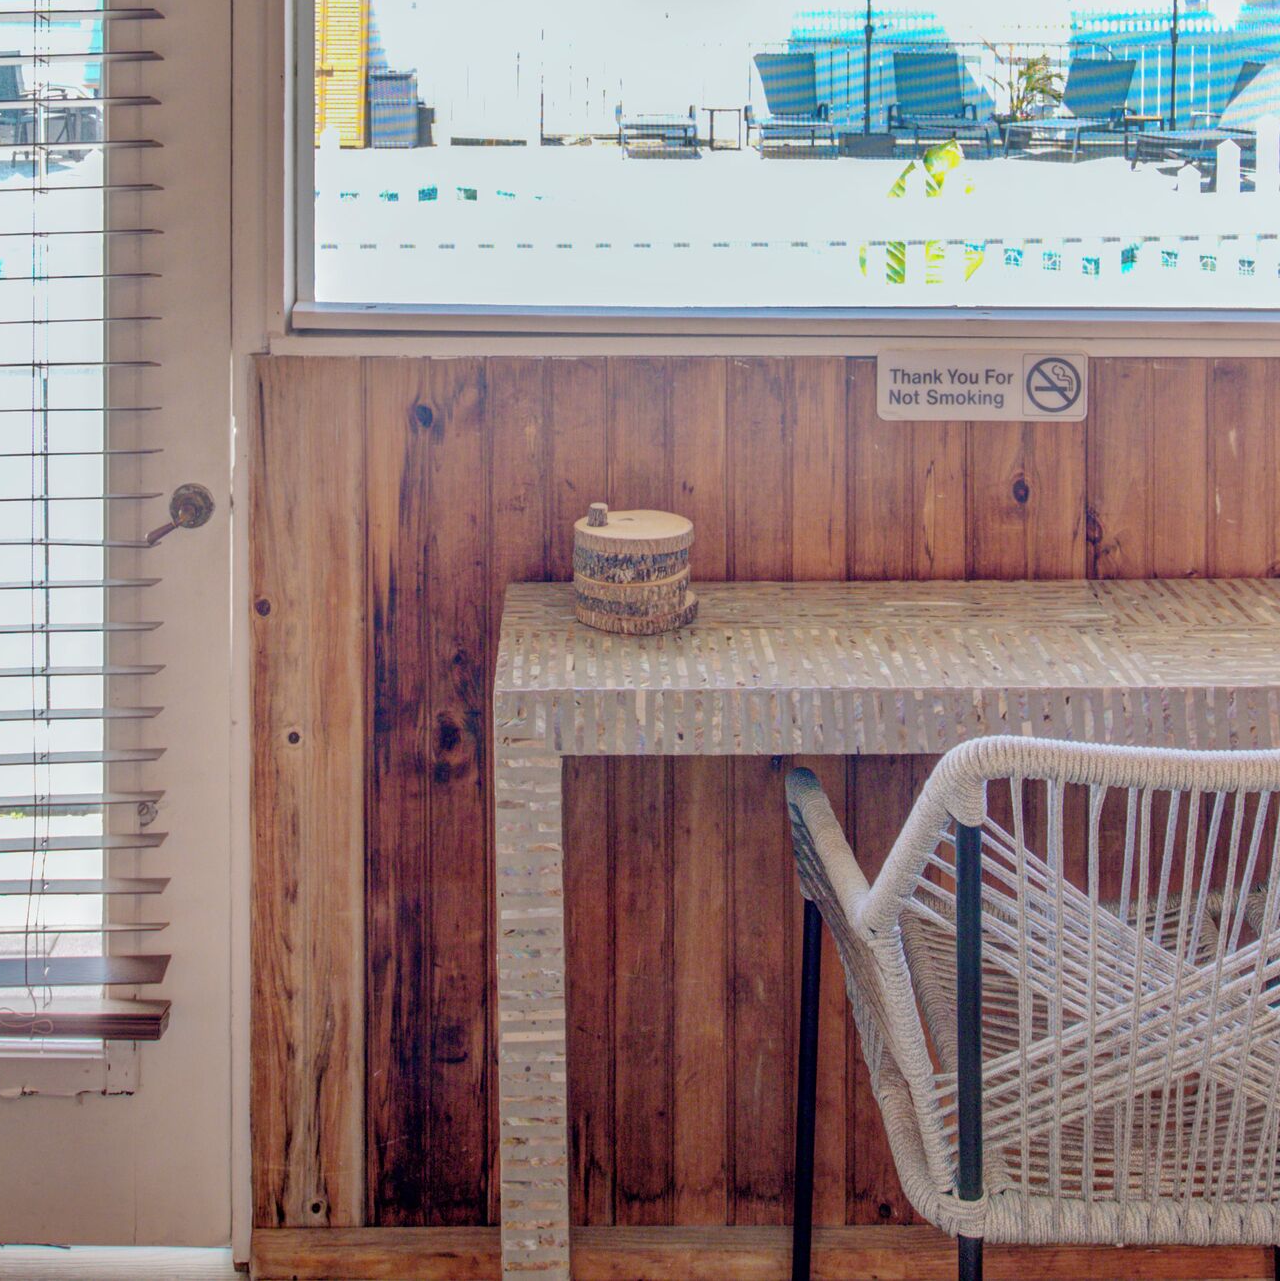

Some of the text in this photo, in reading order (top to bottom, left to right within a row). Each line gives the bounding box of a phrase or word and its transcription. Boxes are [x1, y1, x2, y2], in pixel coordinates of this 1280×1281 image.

[889, 369, 1014, 385] Thank You For
[889, 389, 1005, 409] Not Smoking
